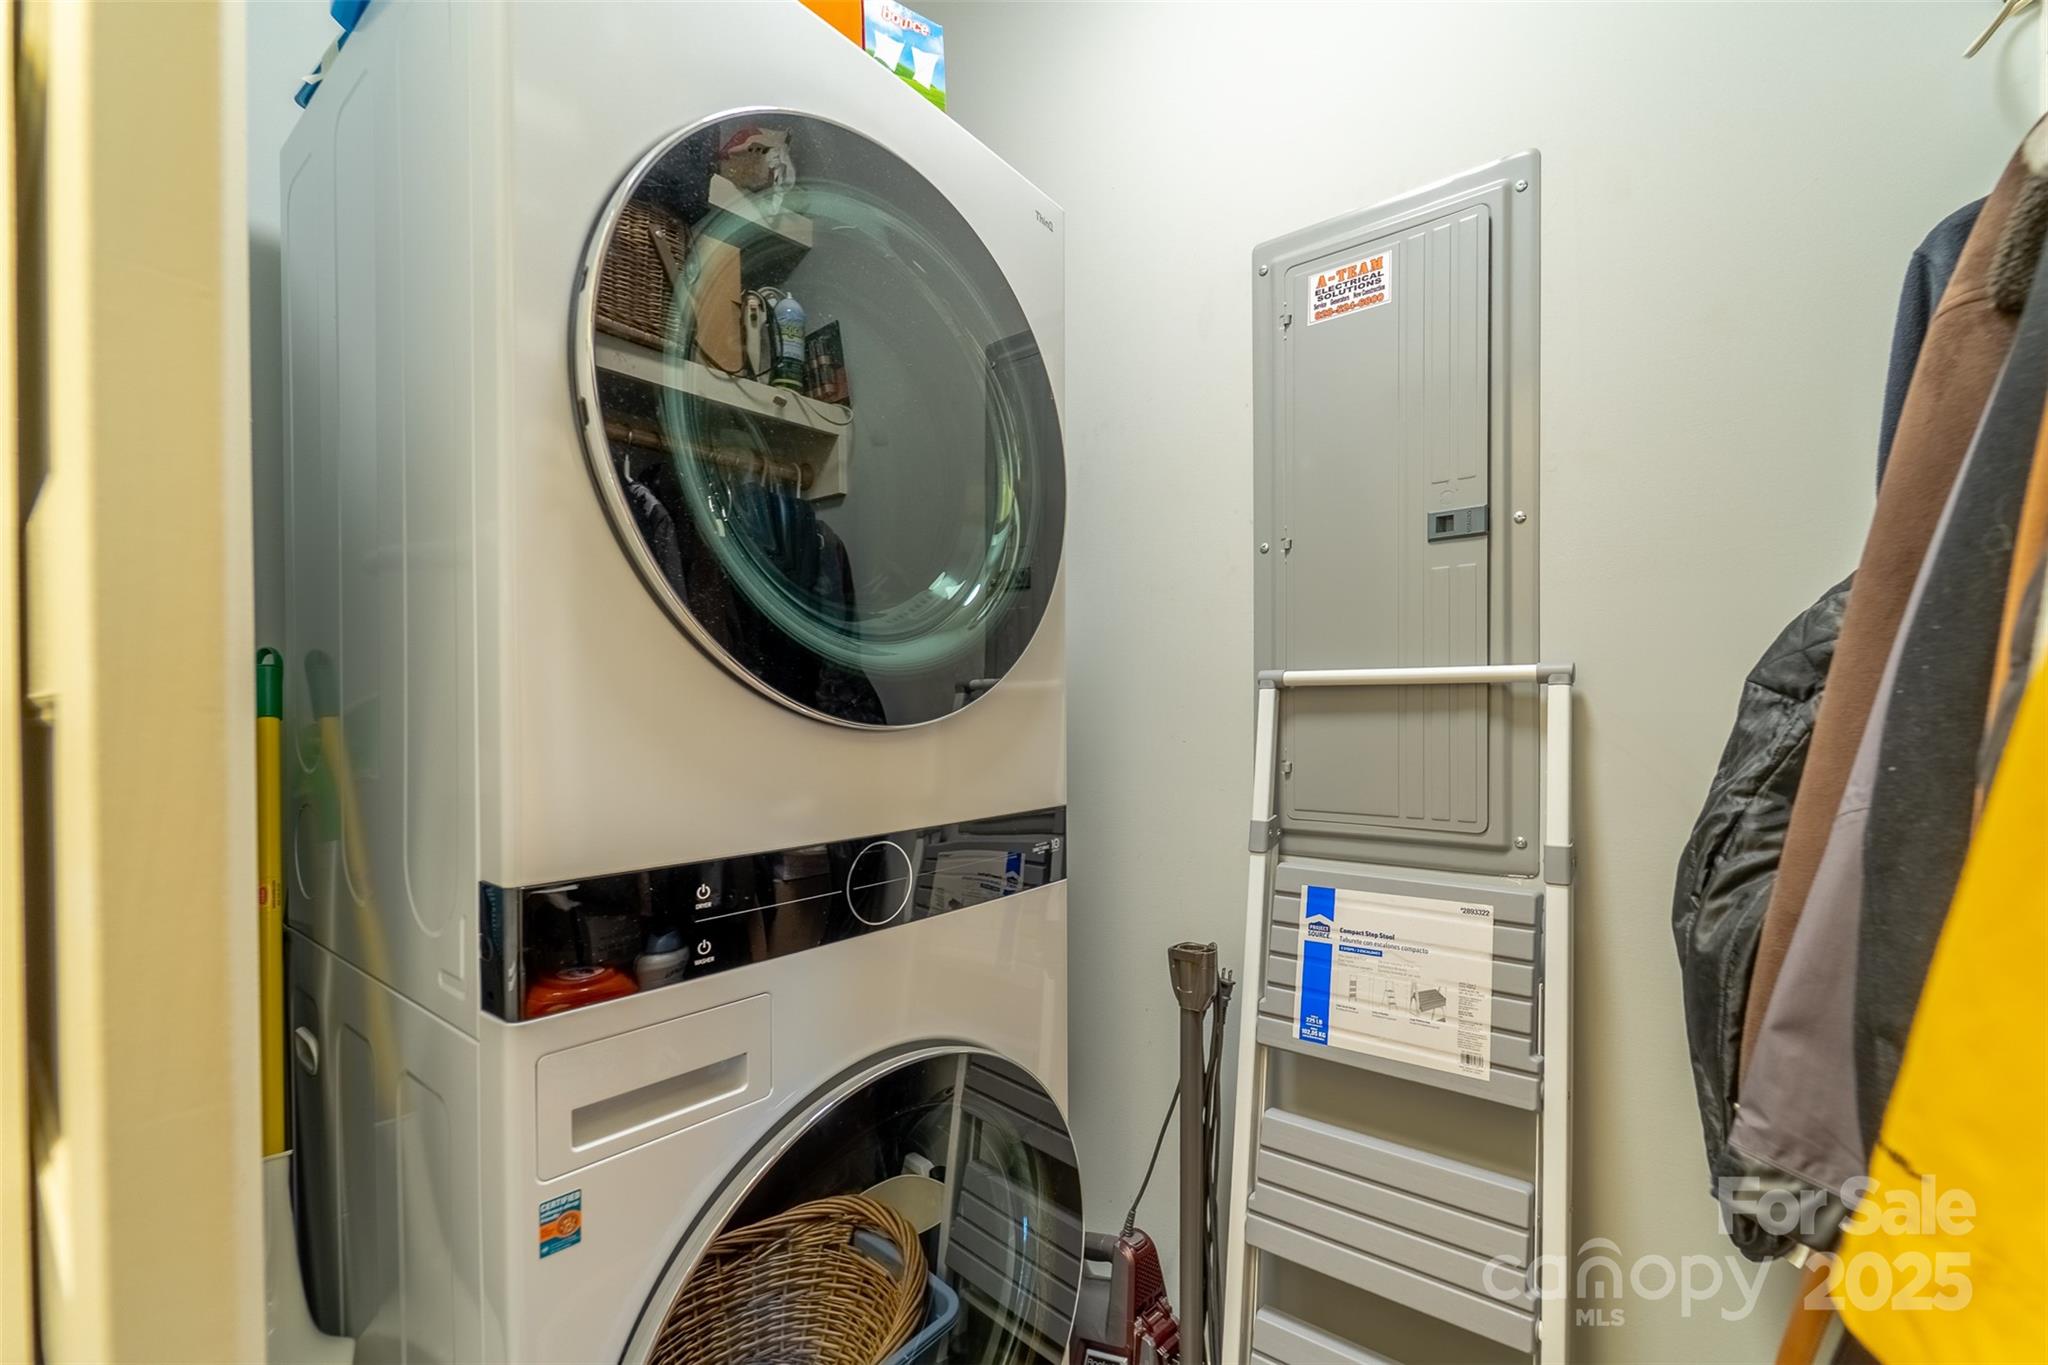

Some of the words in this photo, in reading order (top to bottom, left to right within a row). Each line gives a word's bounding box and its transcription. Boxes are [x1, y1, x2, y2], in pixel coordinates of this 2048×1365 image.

[1035, 210, 1054, 232] ThinQ
[1315, 271, 1384, 296] ELECTRICAL
[1316, 256, 1384, 289] A-TEAM
[1317, 278, 1382, 302] SOLUTIONS
[1308, 930, 1330, 938] SOURCE
[1340, 927, 1364, 937] Compact
[1365, 930, 1379, 939] Step
[1379, 932, 1395, 941] Stool
[1340, 936, 1362, 946] Taburete
[1373, 940, 1400, 951] escalones
[1401, 945, 1429, 954] compacto
